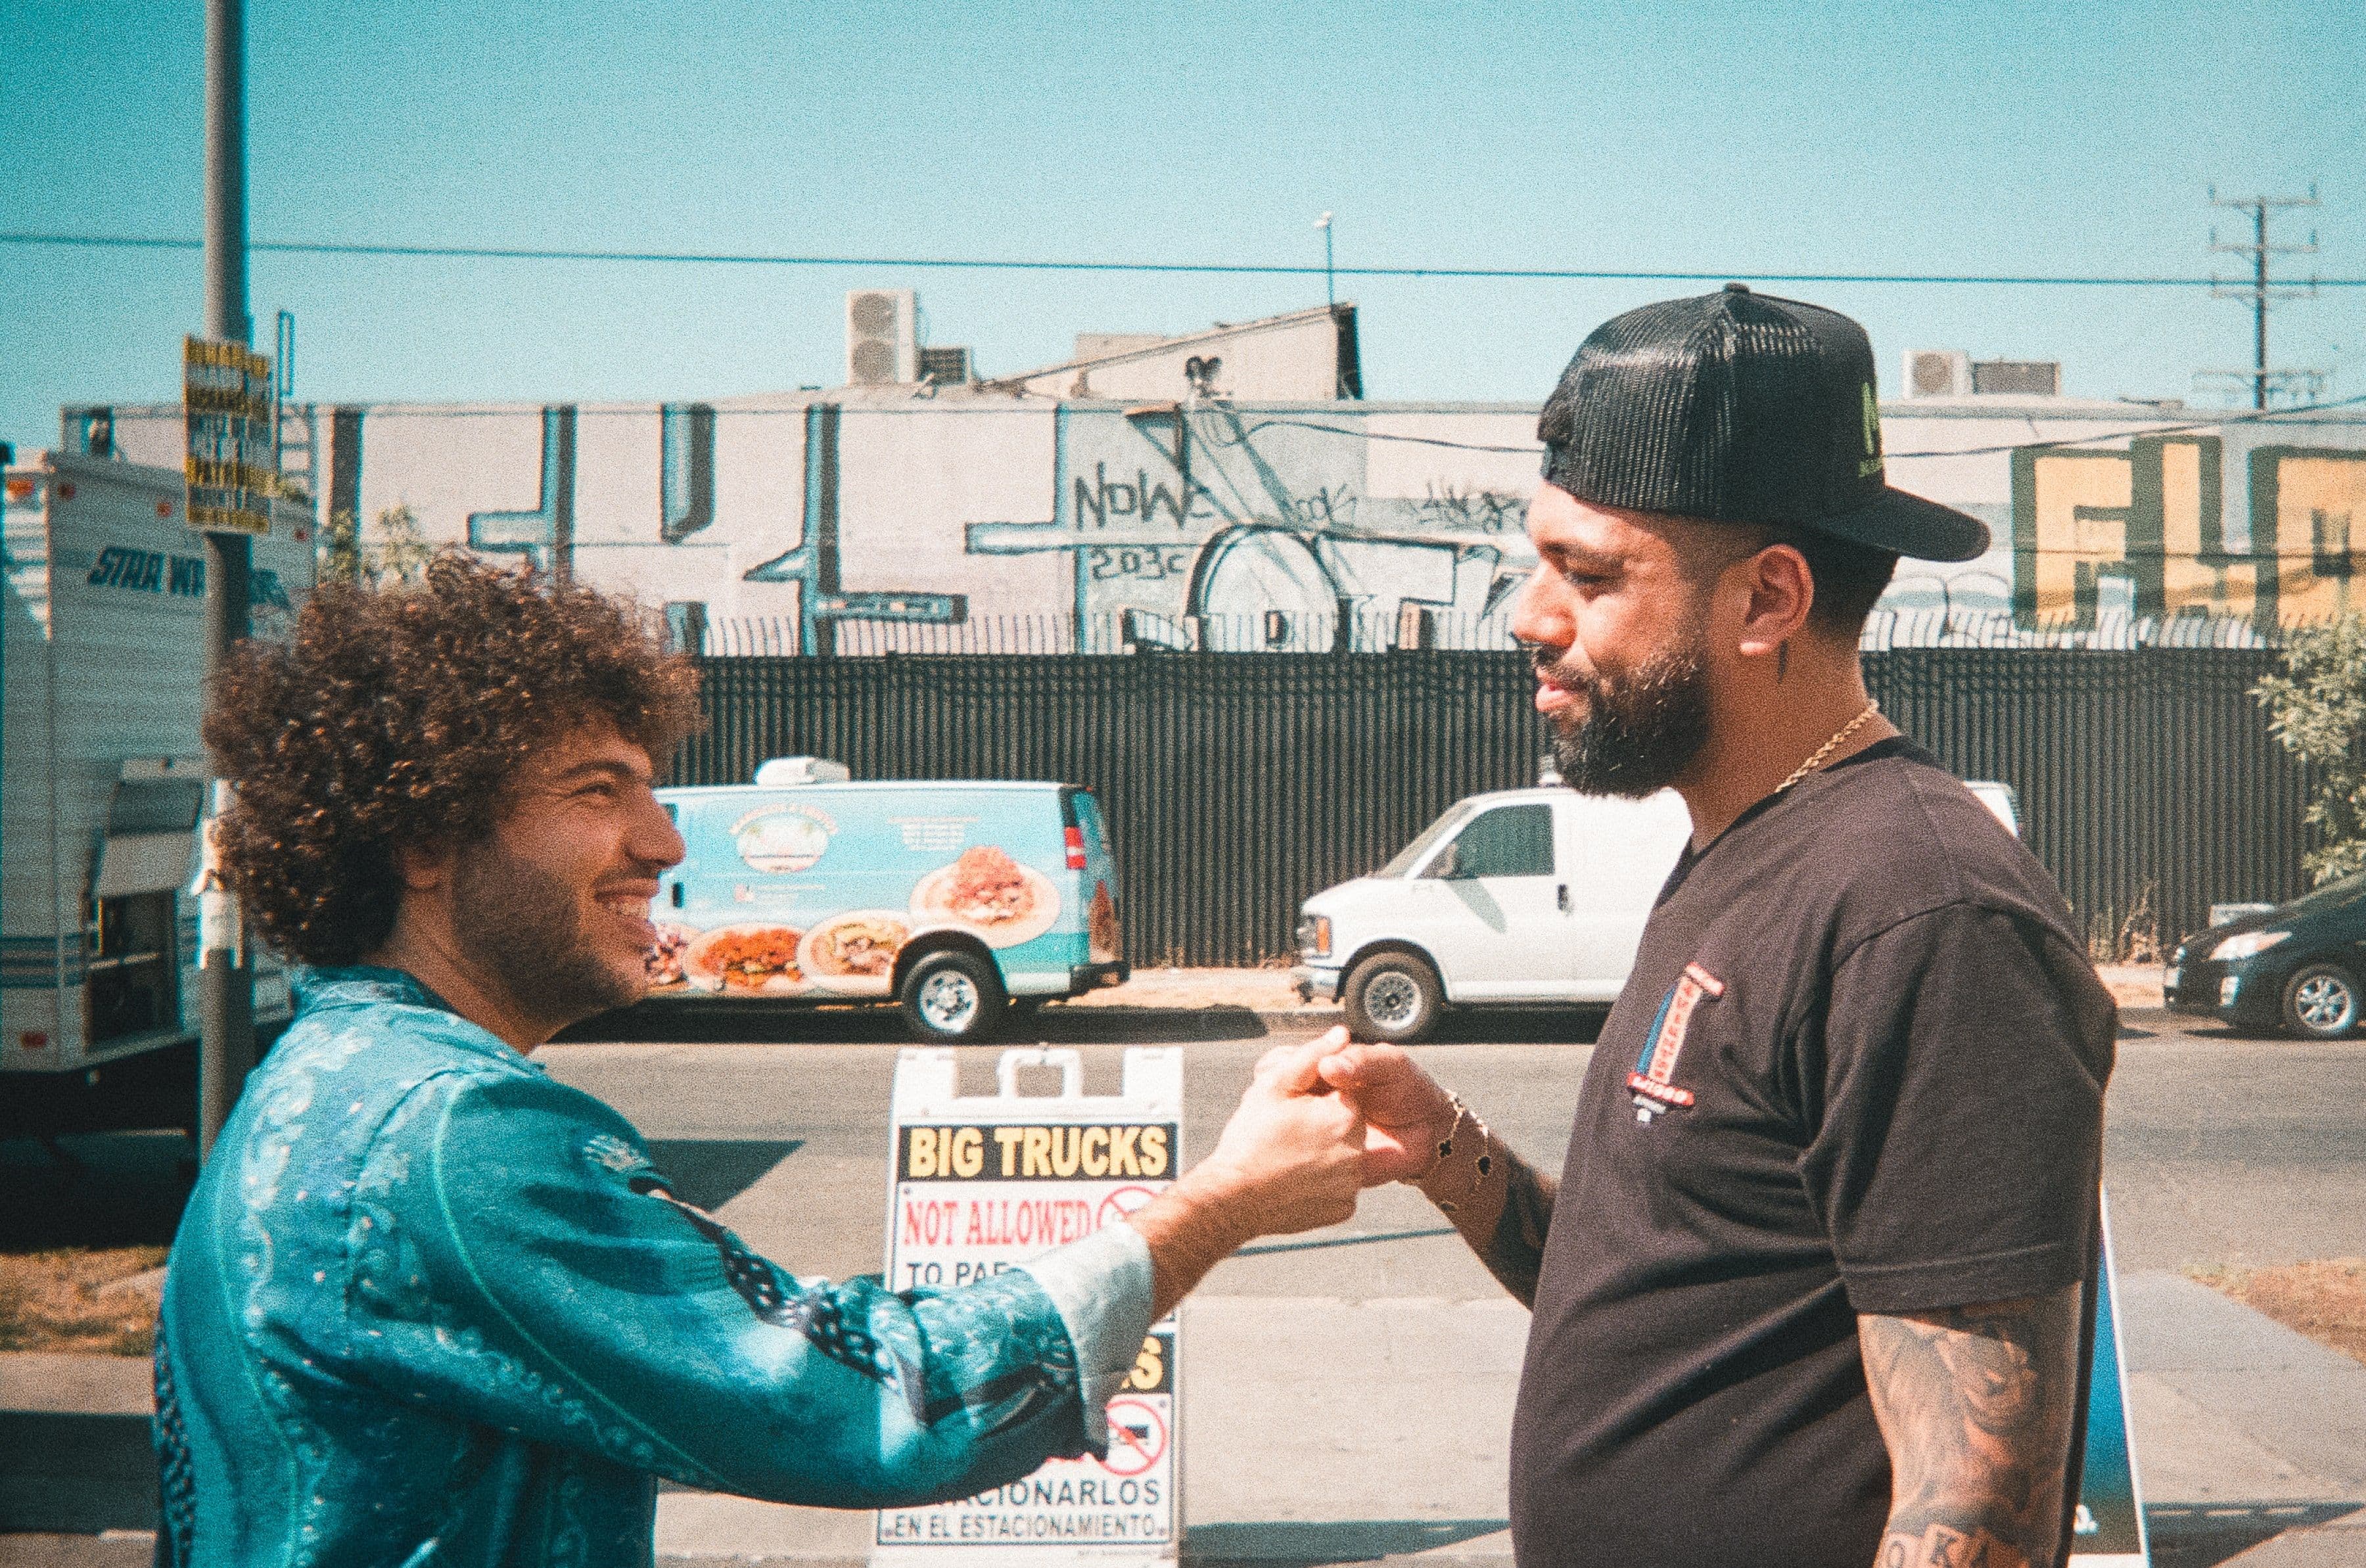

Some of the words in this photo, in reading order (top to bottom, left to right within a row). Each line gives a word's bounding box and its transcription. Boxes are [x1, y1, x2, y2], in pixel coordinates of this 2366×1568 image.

[909, 1126, 984, 1178] BIG
[994, 1126, 1169, 1178] TRUCKS
[904, 1200, 958, 1245] NOT
[965, 1200, 1092, 1246] ALLOWED
[907, 1262, 942, 1287] TO
[895, 1513, 921, 1538] EN
[930, 1513, 952, 1538] EL
[961, 1513, 1156, 1538] ESTACIONAMIENTO
